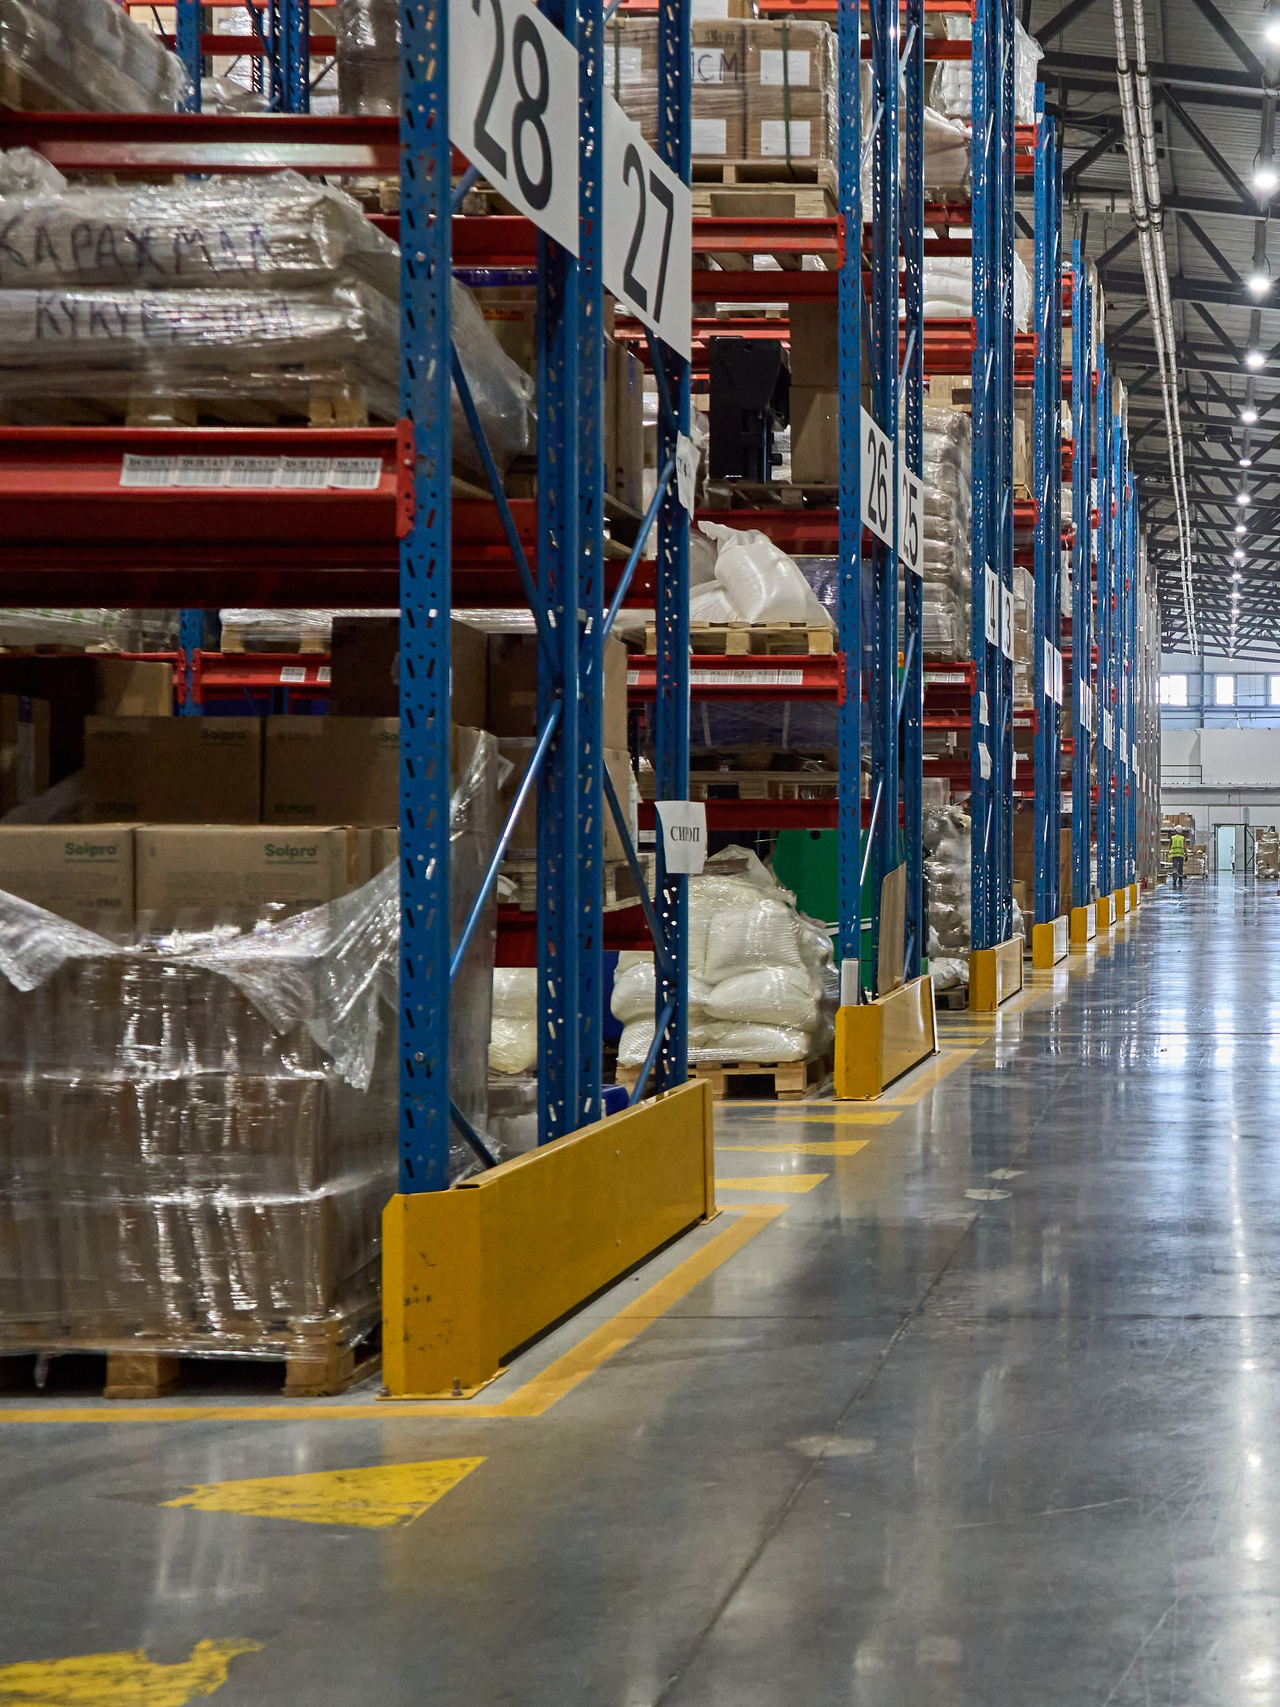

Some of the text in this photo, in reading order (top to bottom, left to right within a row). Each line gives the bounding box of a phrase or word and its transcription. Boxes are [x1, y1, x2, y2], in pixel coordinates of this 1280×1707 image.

[472, 0, 553, 210] 28
[623, 143, 674, 324] 27
[867, 428, 888, 534] 26
[903, 473, 918, 567] 25
[264, 844, 318, 860] Solpro
